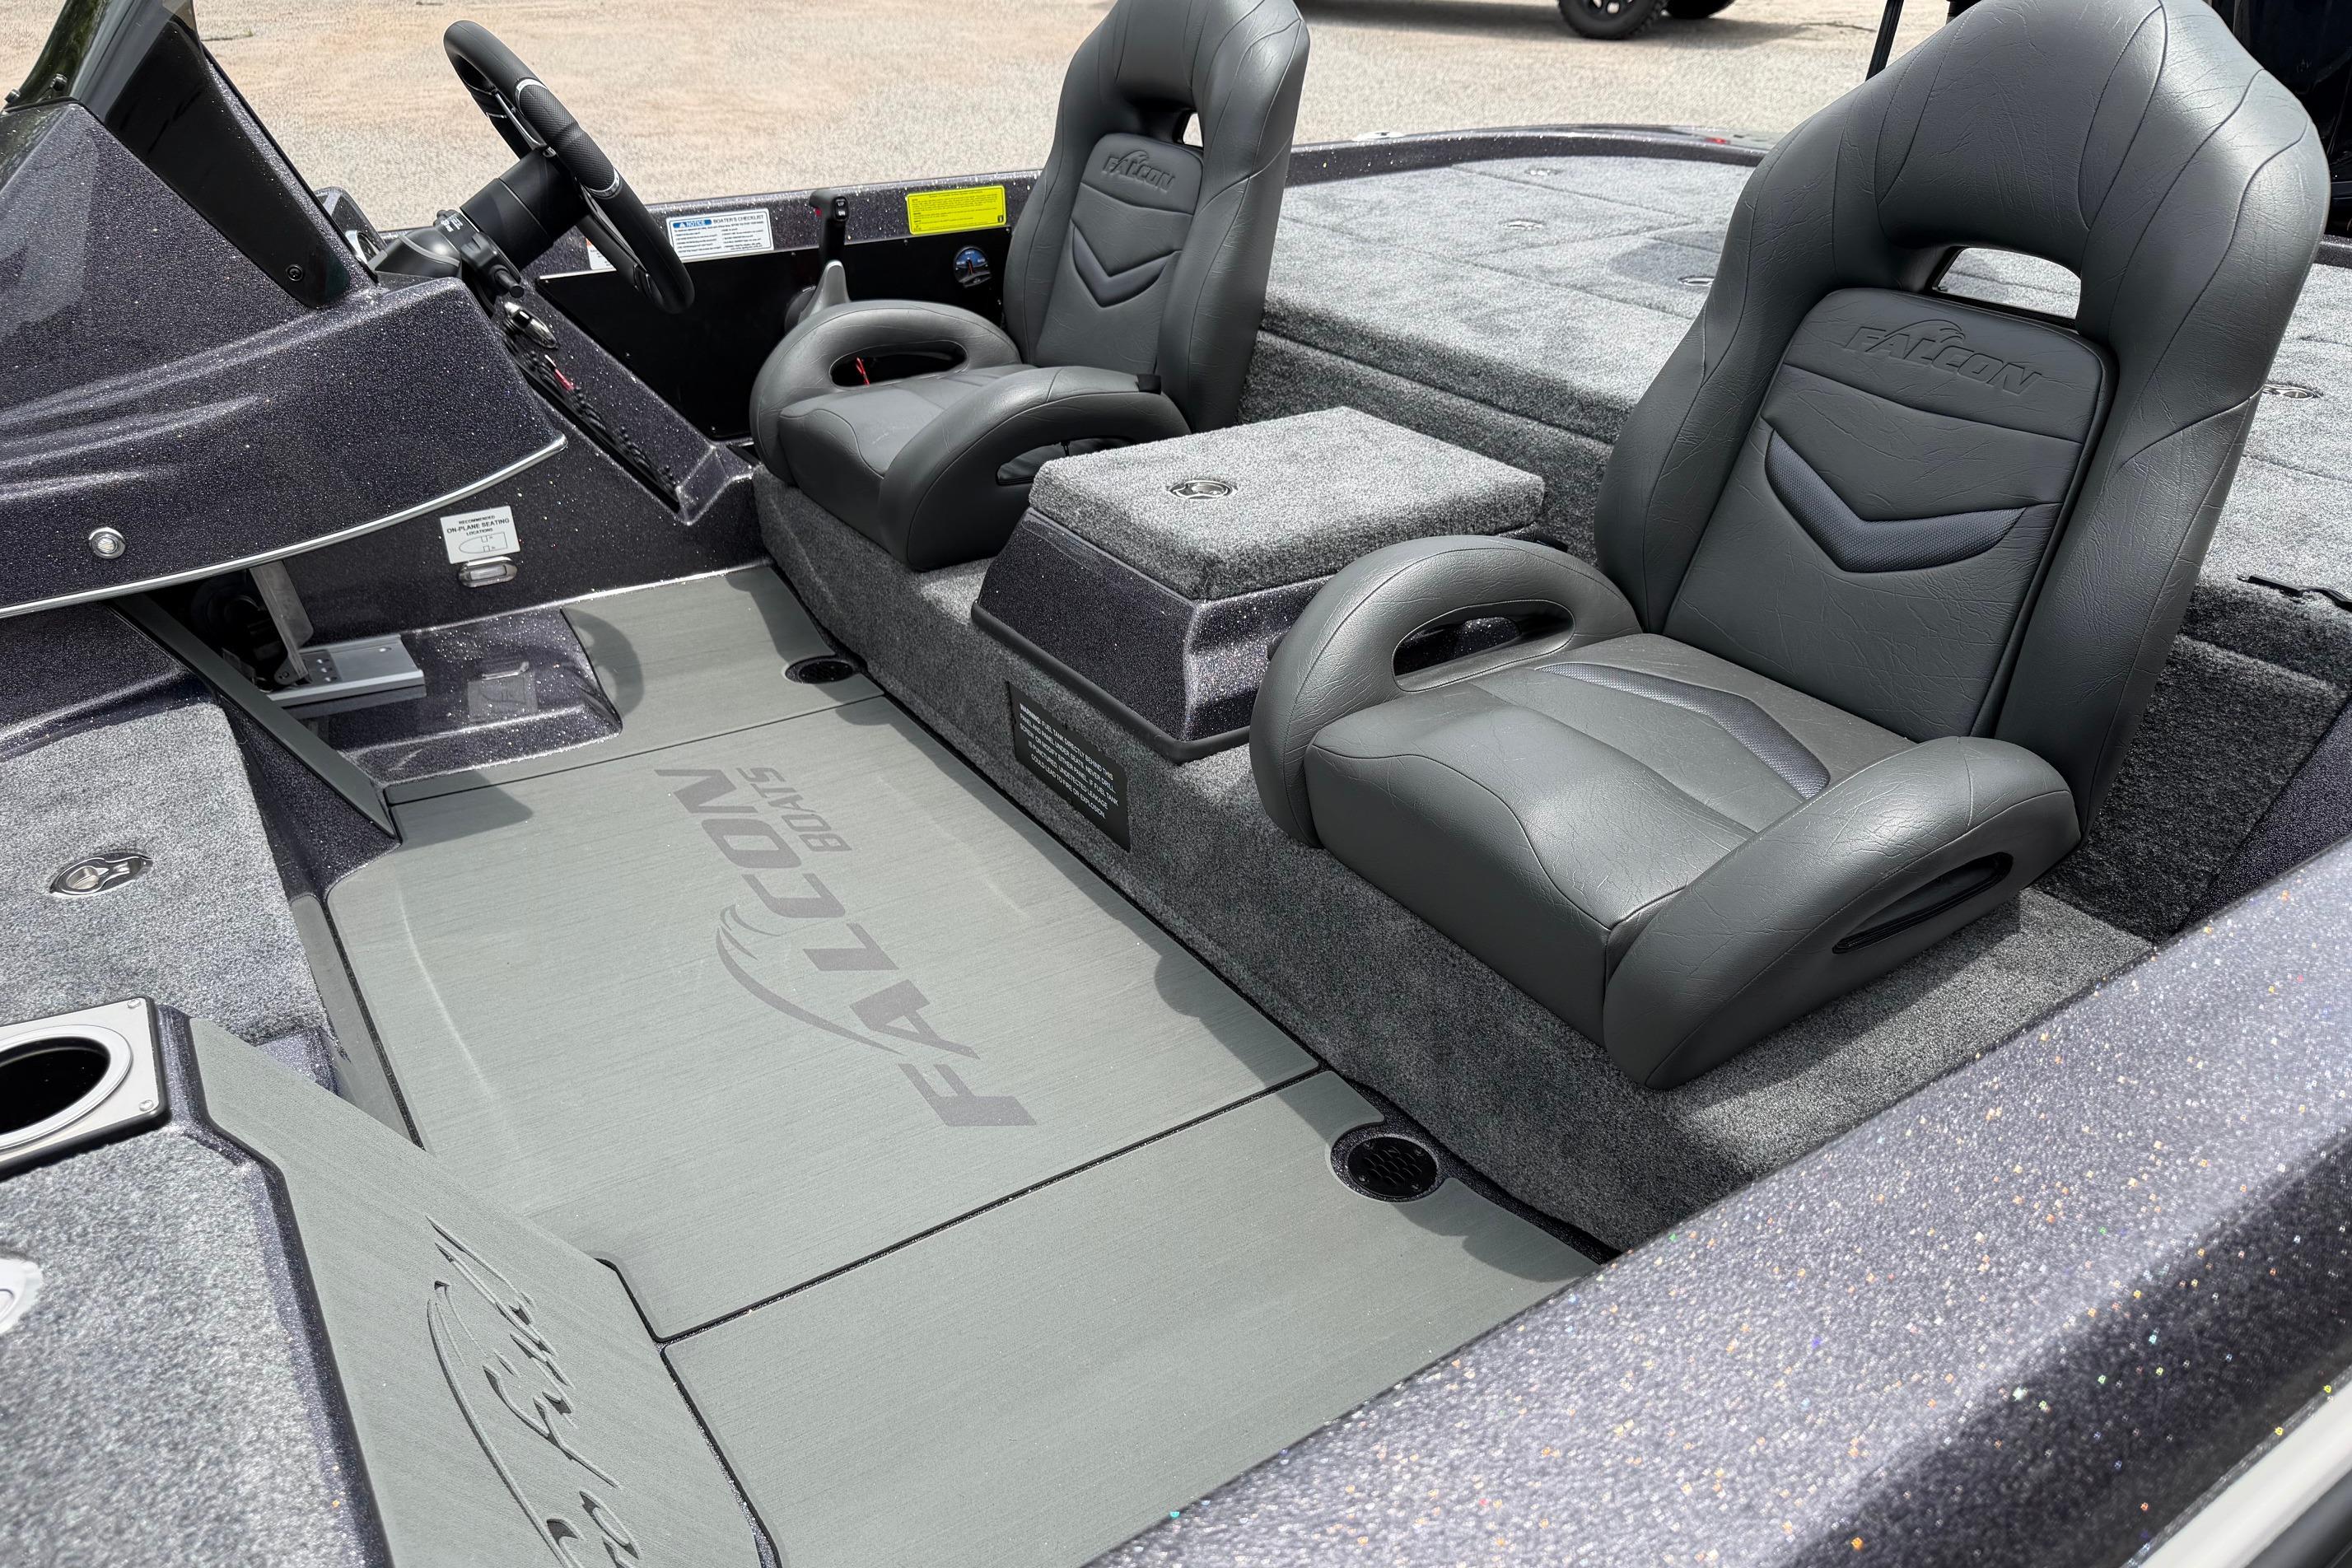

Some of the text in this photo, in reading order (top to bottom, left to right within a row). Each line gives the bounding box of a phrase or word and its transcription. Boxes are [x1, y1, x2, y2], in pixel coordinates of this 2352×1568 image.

[1101, 152, 1176, 194] FALCON
[1841, 325, 2042, 396] FALCON
[446, 518, 510, 534] ON-PLANE SEATING
[458, 516, 496, 525] RECOMMENDED
[465, 528, 493, 536] LOCATIONS
[1020, 714, 1033, 728] PANEL
[1033, 724, 1041, 735] AND
[1042, 730, 1054, 745] PANEL
[1055, 740, 1071, 758] UNDER
[1085, 764, 1101, 782] NEVER
[1035, 735, 1042, 745] OR
[1042, 740, 1057, 758] MODIFY
[1058, 754, 1073, 770] EITHER
[1094, 782, 1106, 796] FUEL
[1106, 791, 1118, 806] TANK
[1042, 721, 1052, 734] FUEL
[1053, 729, 1064, 742] TANK
[1065, 738, 1085, 758] DIRECTLY
[1085, 754, 1102, 771] BEHIND
[1103, 767, 1113, 780] THIS
[1031, 753, 1045, 769] COULD
[1045, 765, 1056, 778] LEAD
[1057, 774, 1062, 783] TO
[1063, 779, 1072, 791] FIRE
[1073, 787, 1080, 797] OR
[1059, 765, 1087, 792] UNDETECTED
[735, 767, 853, 852] BOATS
[653, 768, 1038, 1127] FALCON
